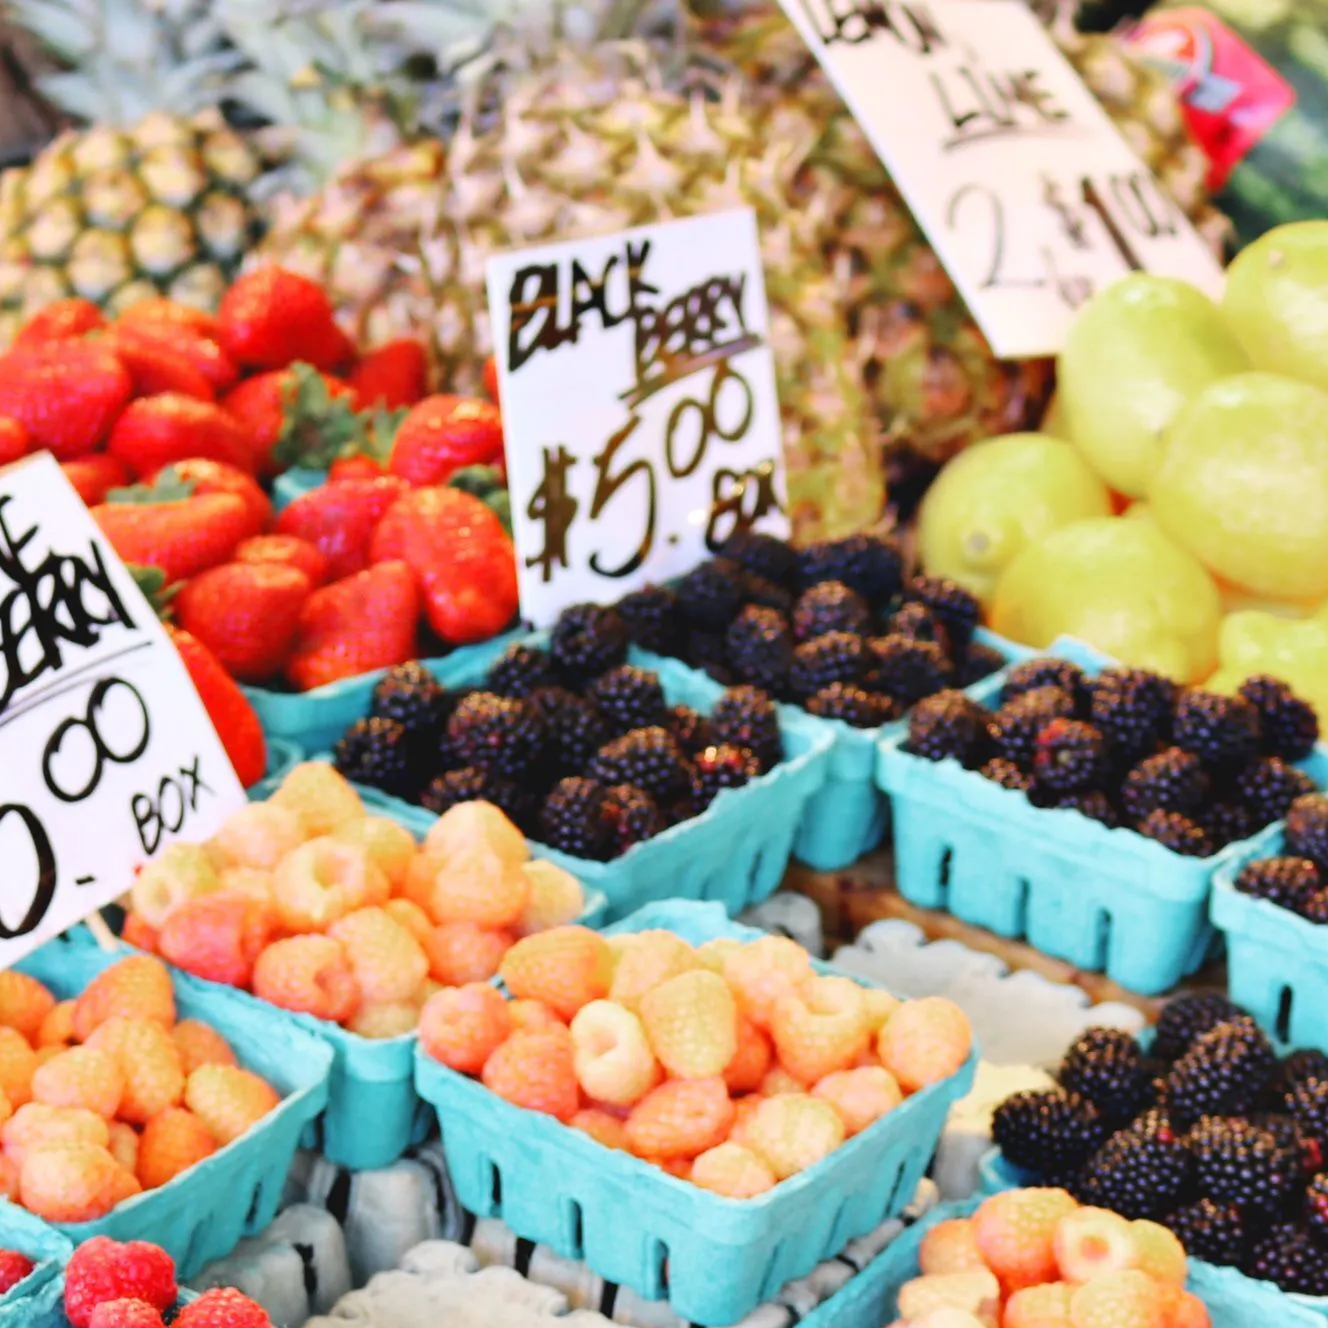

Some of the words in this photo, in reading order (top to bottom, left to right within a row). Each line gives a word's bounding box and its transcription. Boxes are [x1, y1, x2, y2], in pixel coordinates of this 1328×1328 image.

[944, 180, 1048, 292] 2
[508, 239, 660, 373] BLACK
[629, 272, 748, 390] BERRY
[131, 754, 218, 856] BOX
